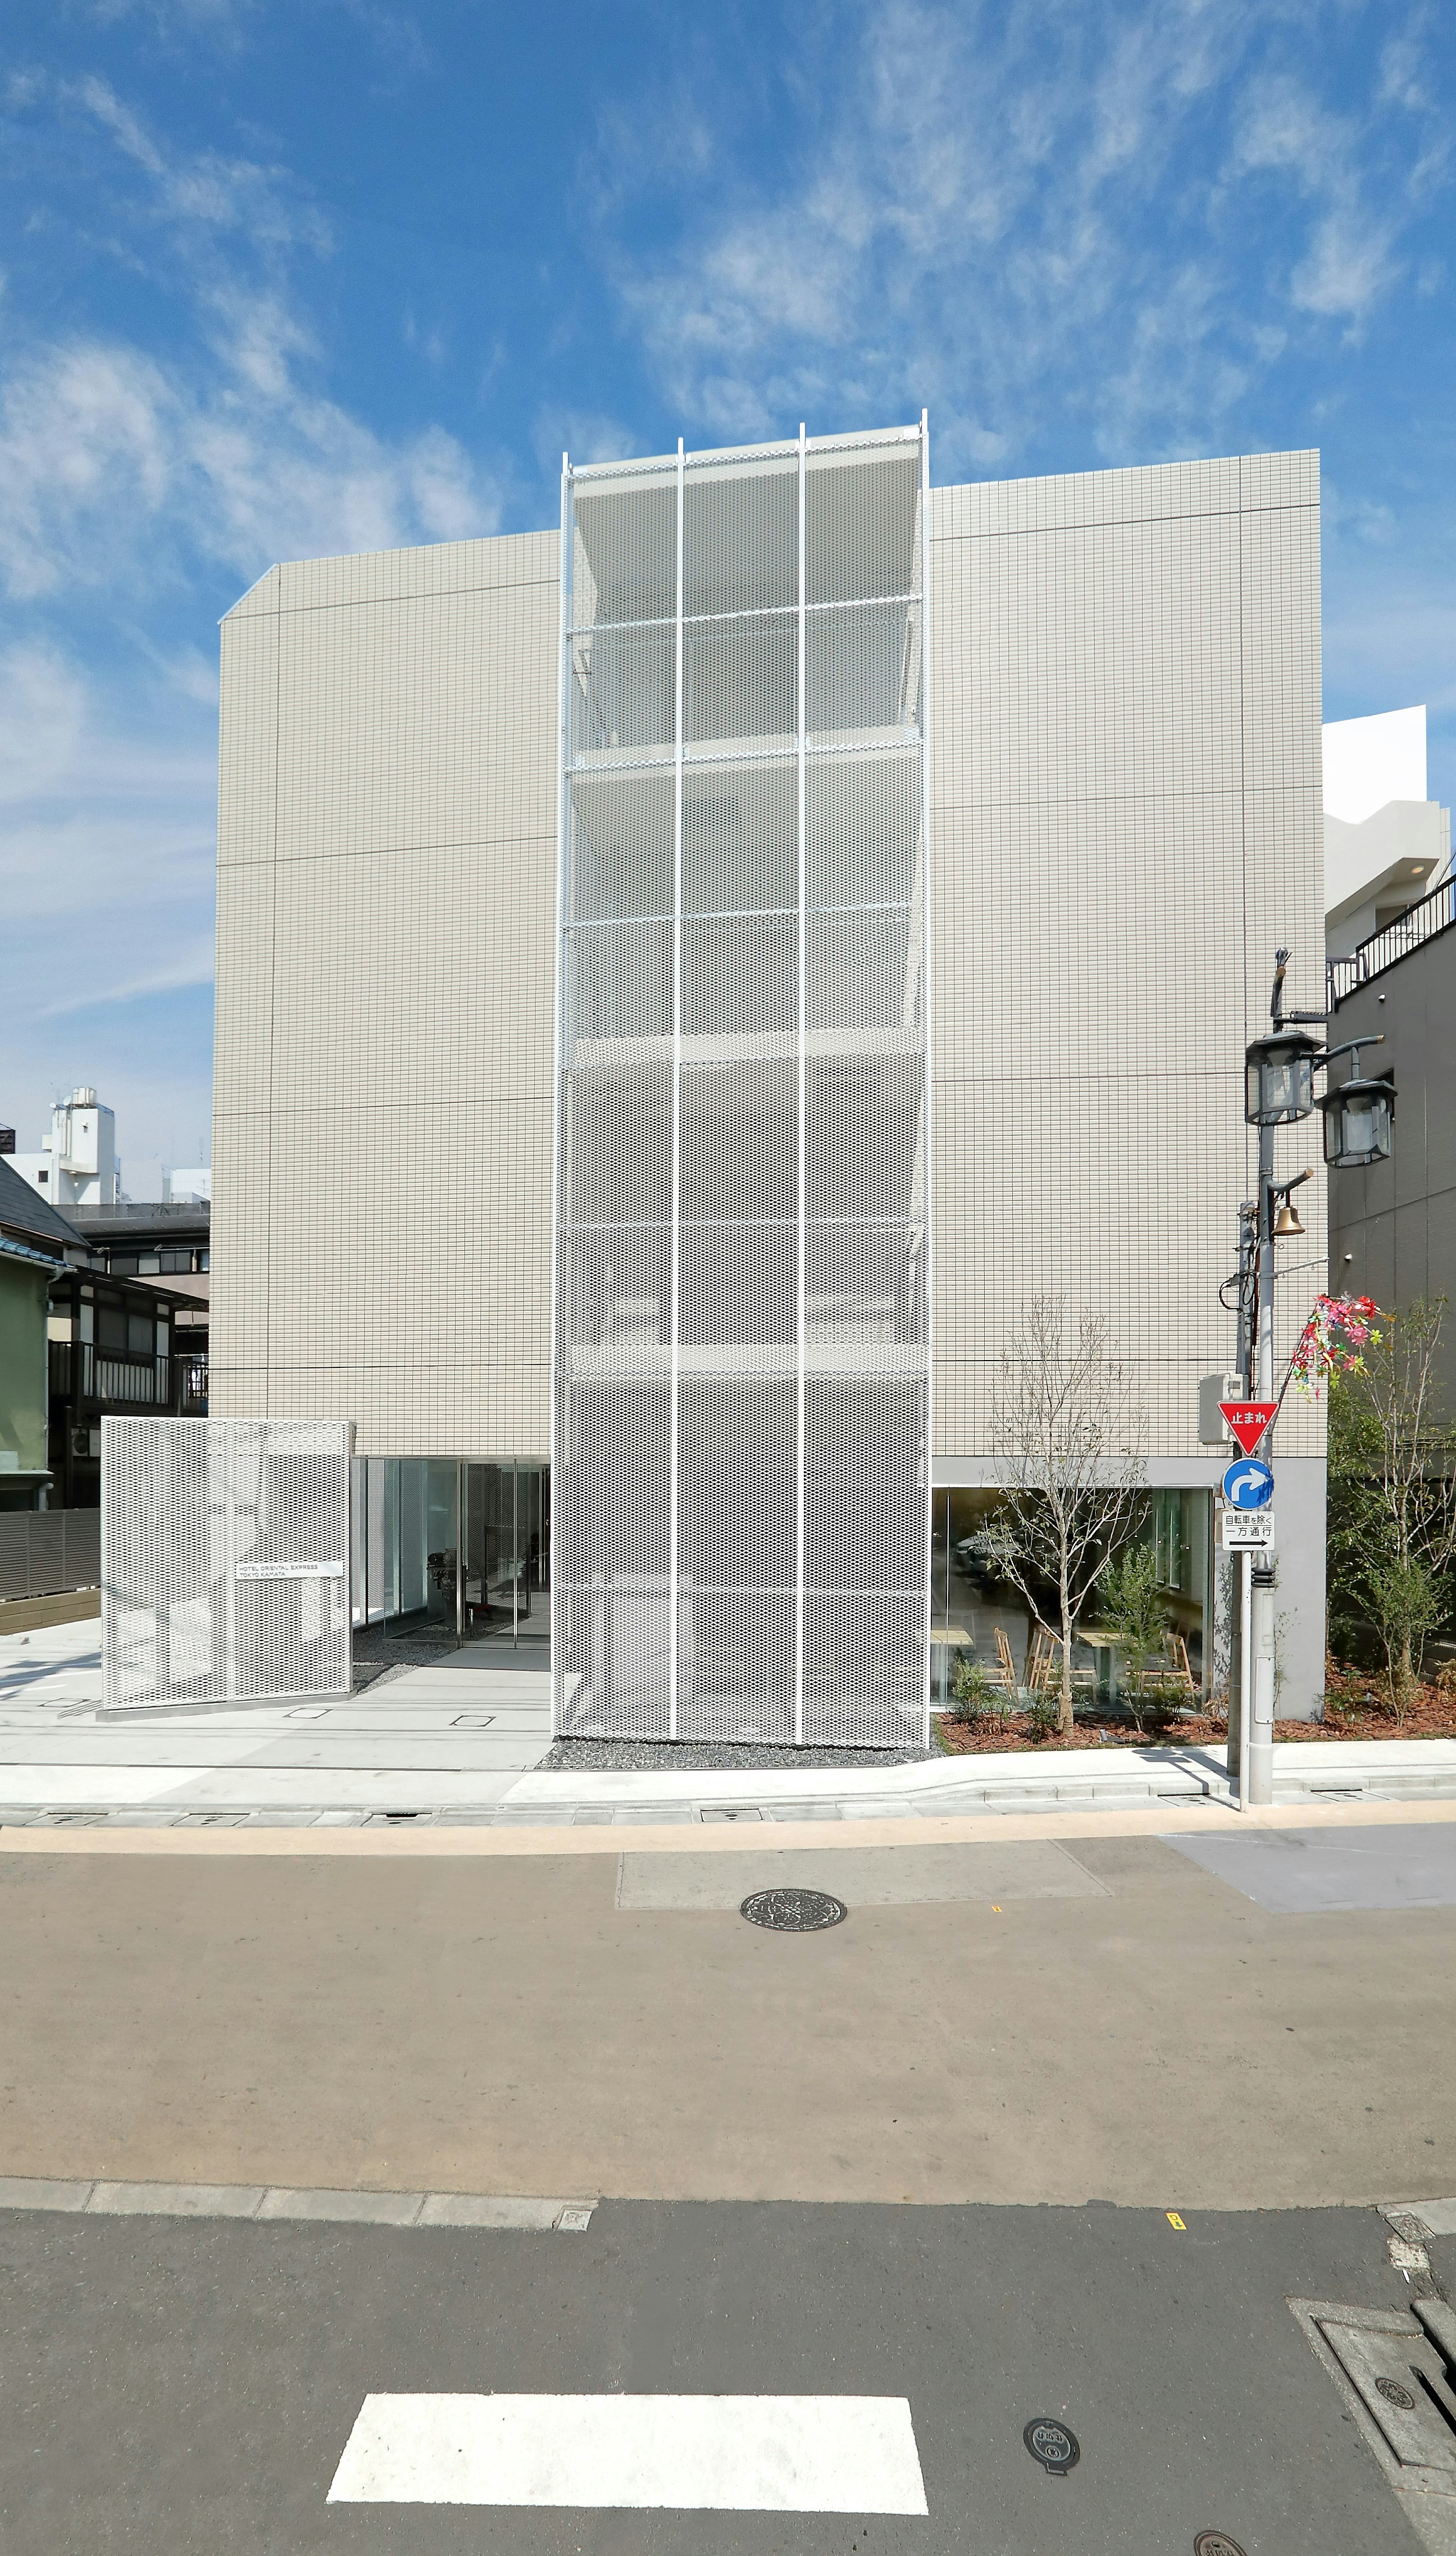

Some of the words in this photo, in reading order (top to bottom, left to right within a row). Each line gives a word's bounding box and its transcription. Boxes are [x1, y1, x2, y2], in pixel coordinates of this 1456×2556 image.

[1231, 1412, 1267, 1424] 止まれ
[1226, 1515, 1271, 1525] 自転車を除く
[1226, 1527, 1272, 1536] 一方通行
